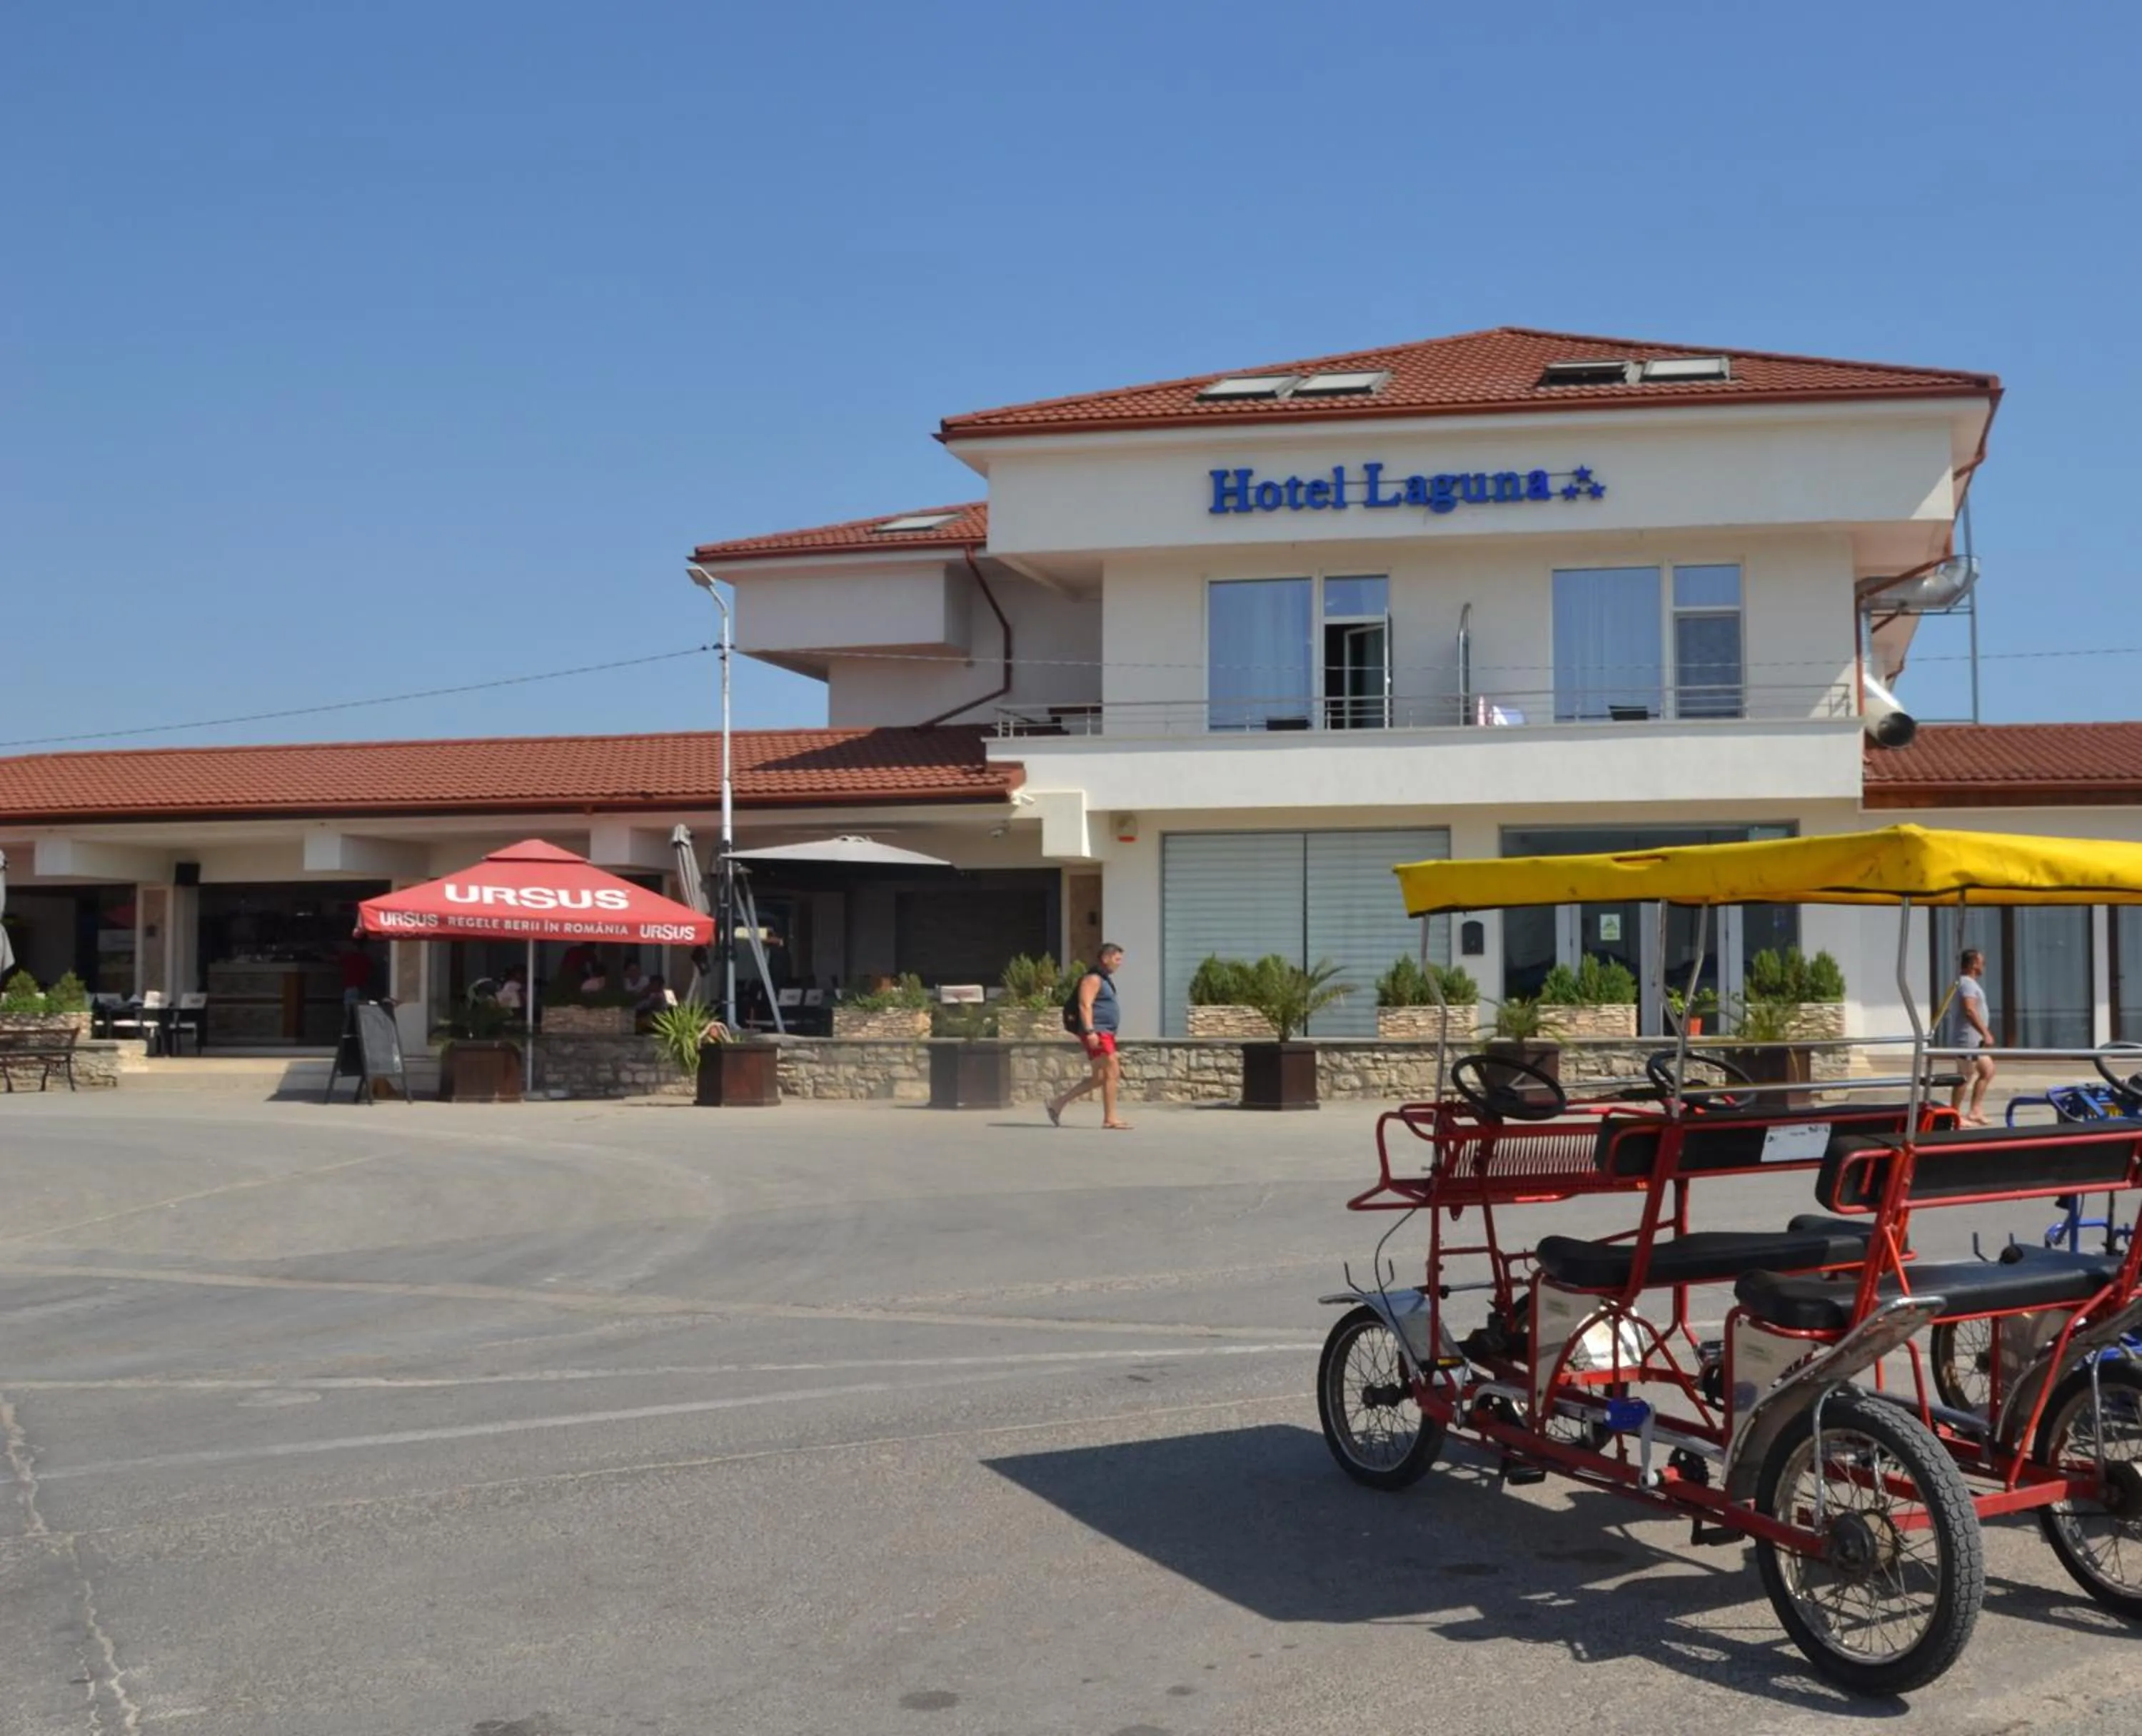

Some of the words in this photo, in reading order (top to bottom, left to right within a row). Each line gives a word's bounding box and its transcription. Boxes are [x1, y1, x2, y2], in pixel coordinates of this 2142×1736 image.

[1209, 465, 1349, 514] Hotel
[1363, 462, 1553, 513] Laguna
[443, 883, 630, 910] URSUS
[378, 911, 438, 928] URSUS
[448, 915, 500, 929] REGELE
[504, 919, 540, 932] BERII
[544, 919, 559, 933] ÎN
[563, 922, 629, 935] ROMÂNIA
[639, 924, 695, 941] URSUS
